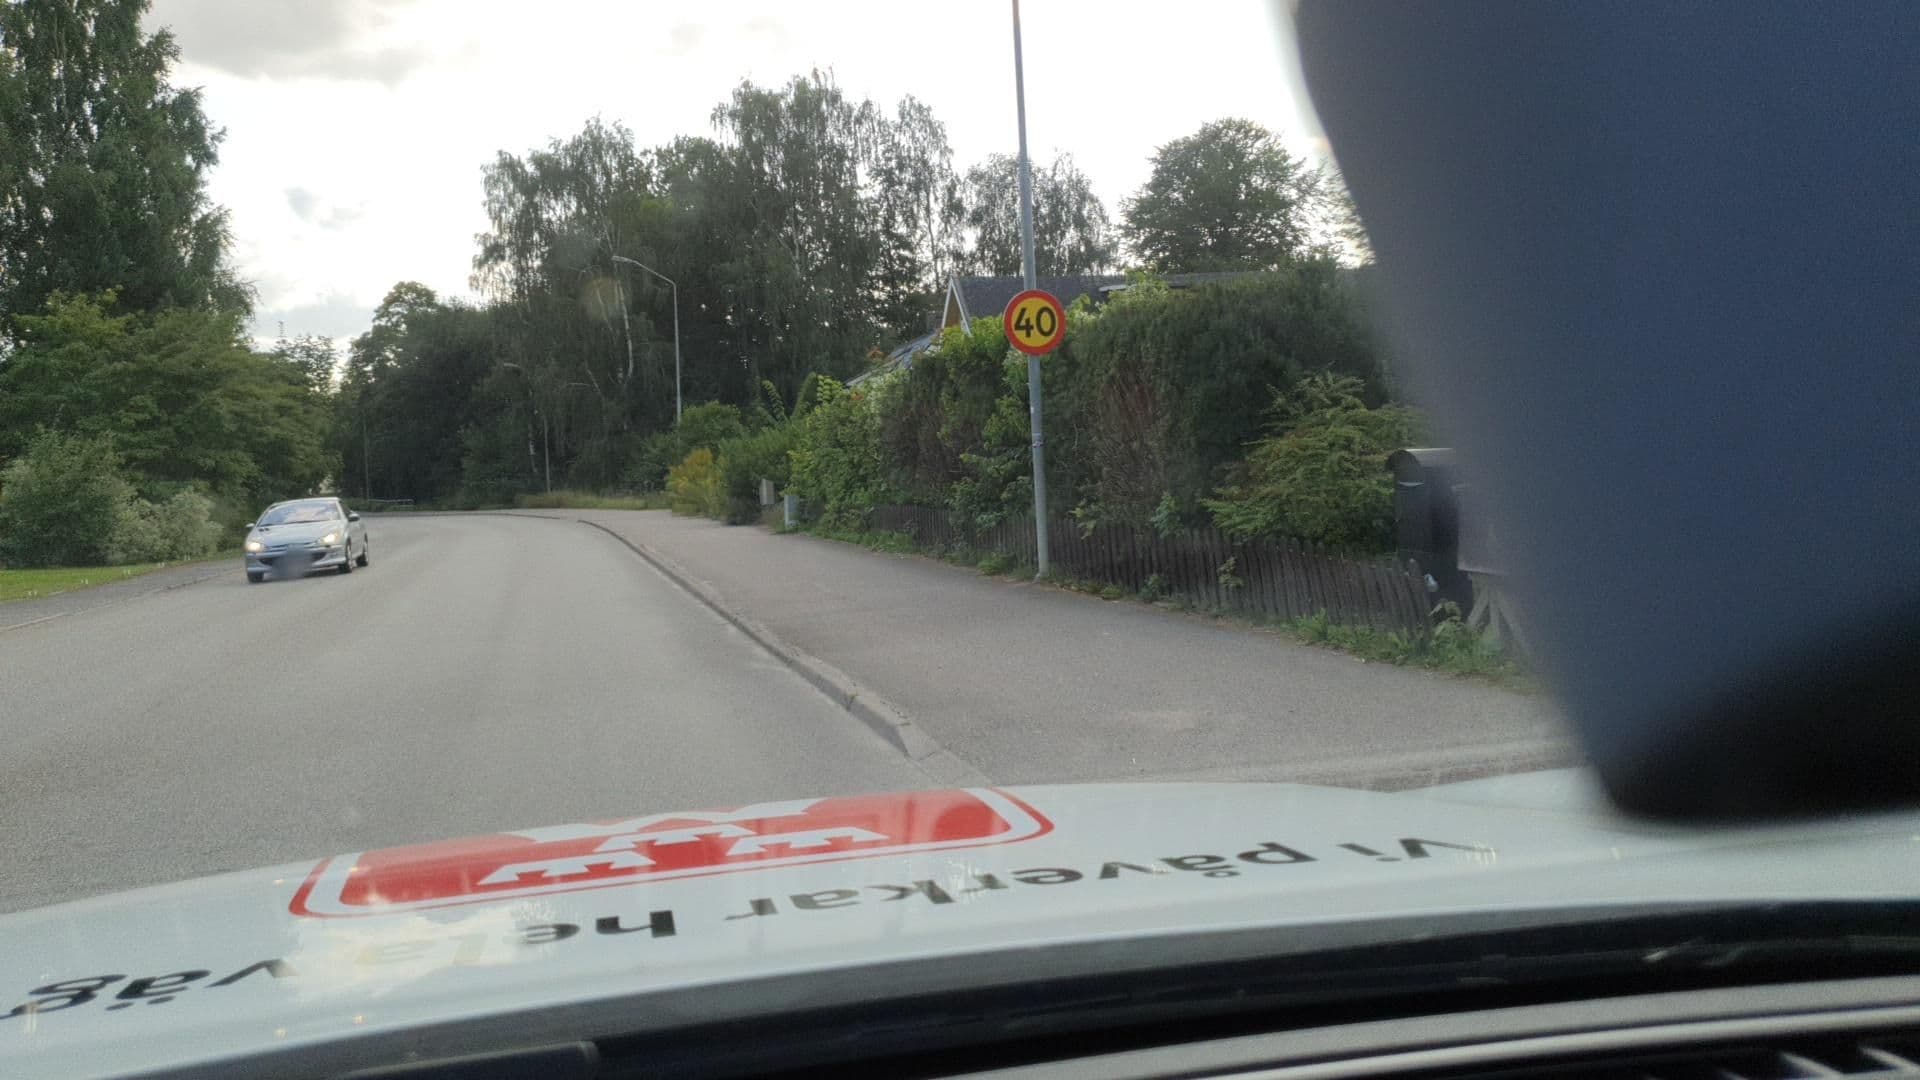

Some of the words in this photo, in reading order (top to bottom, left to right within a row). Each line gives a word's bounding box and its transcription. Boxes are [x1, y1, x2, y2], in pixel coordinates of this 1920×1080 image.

[1014, 306, 1057, 338] 40
[1335, 837, 1497, 864] Vi
[723, 841, 1318, 921] påverkar
